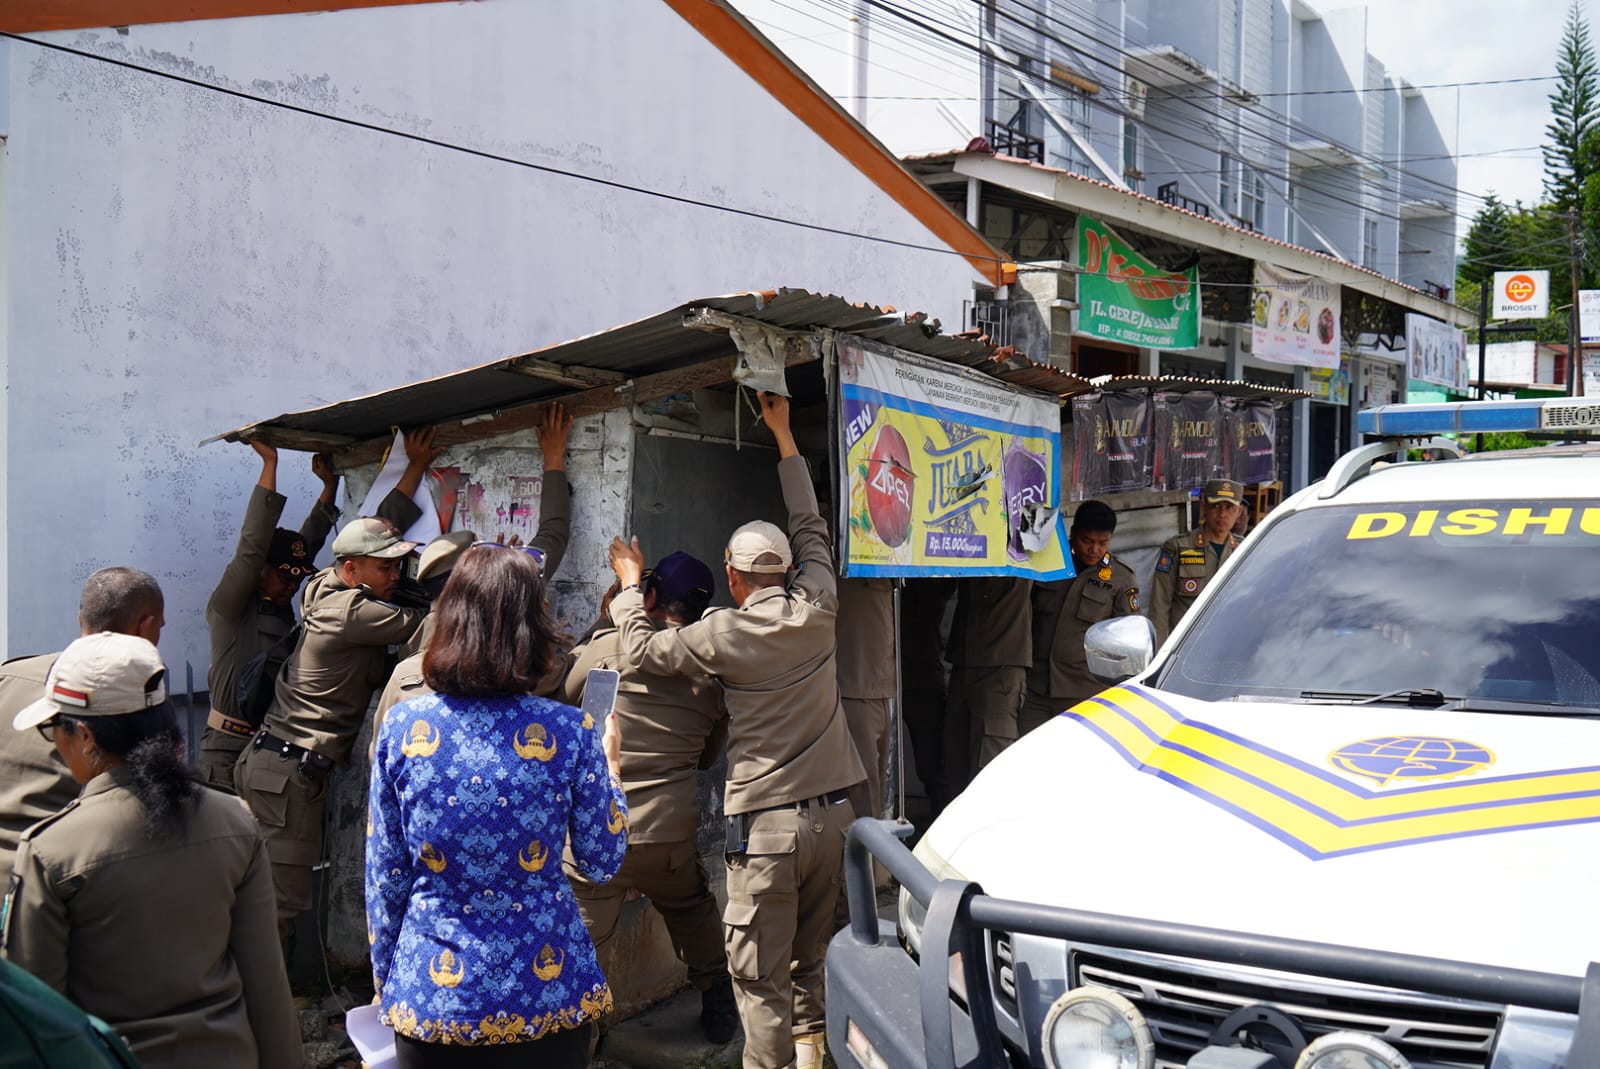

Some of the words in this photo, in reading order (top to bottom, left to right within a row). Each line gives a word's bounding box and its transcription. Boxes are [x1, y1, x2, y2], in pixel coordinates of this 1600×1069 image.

[1090, 300, 1107, 318] JL.
[1108, 304, 1152, 330] GEREJA
[1501, 304, 1538, 312] BROSIST
[845, 403, 873, 451] NEW
[870, 466, 911, 512] APEL
[1011, 481, 1046, 516] ERRY
